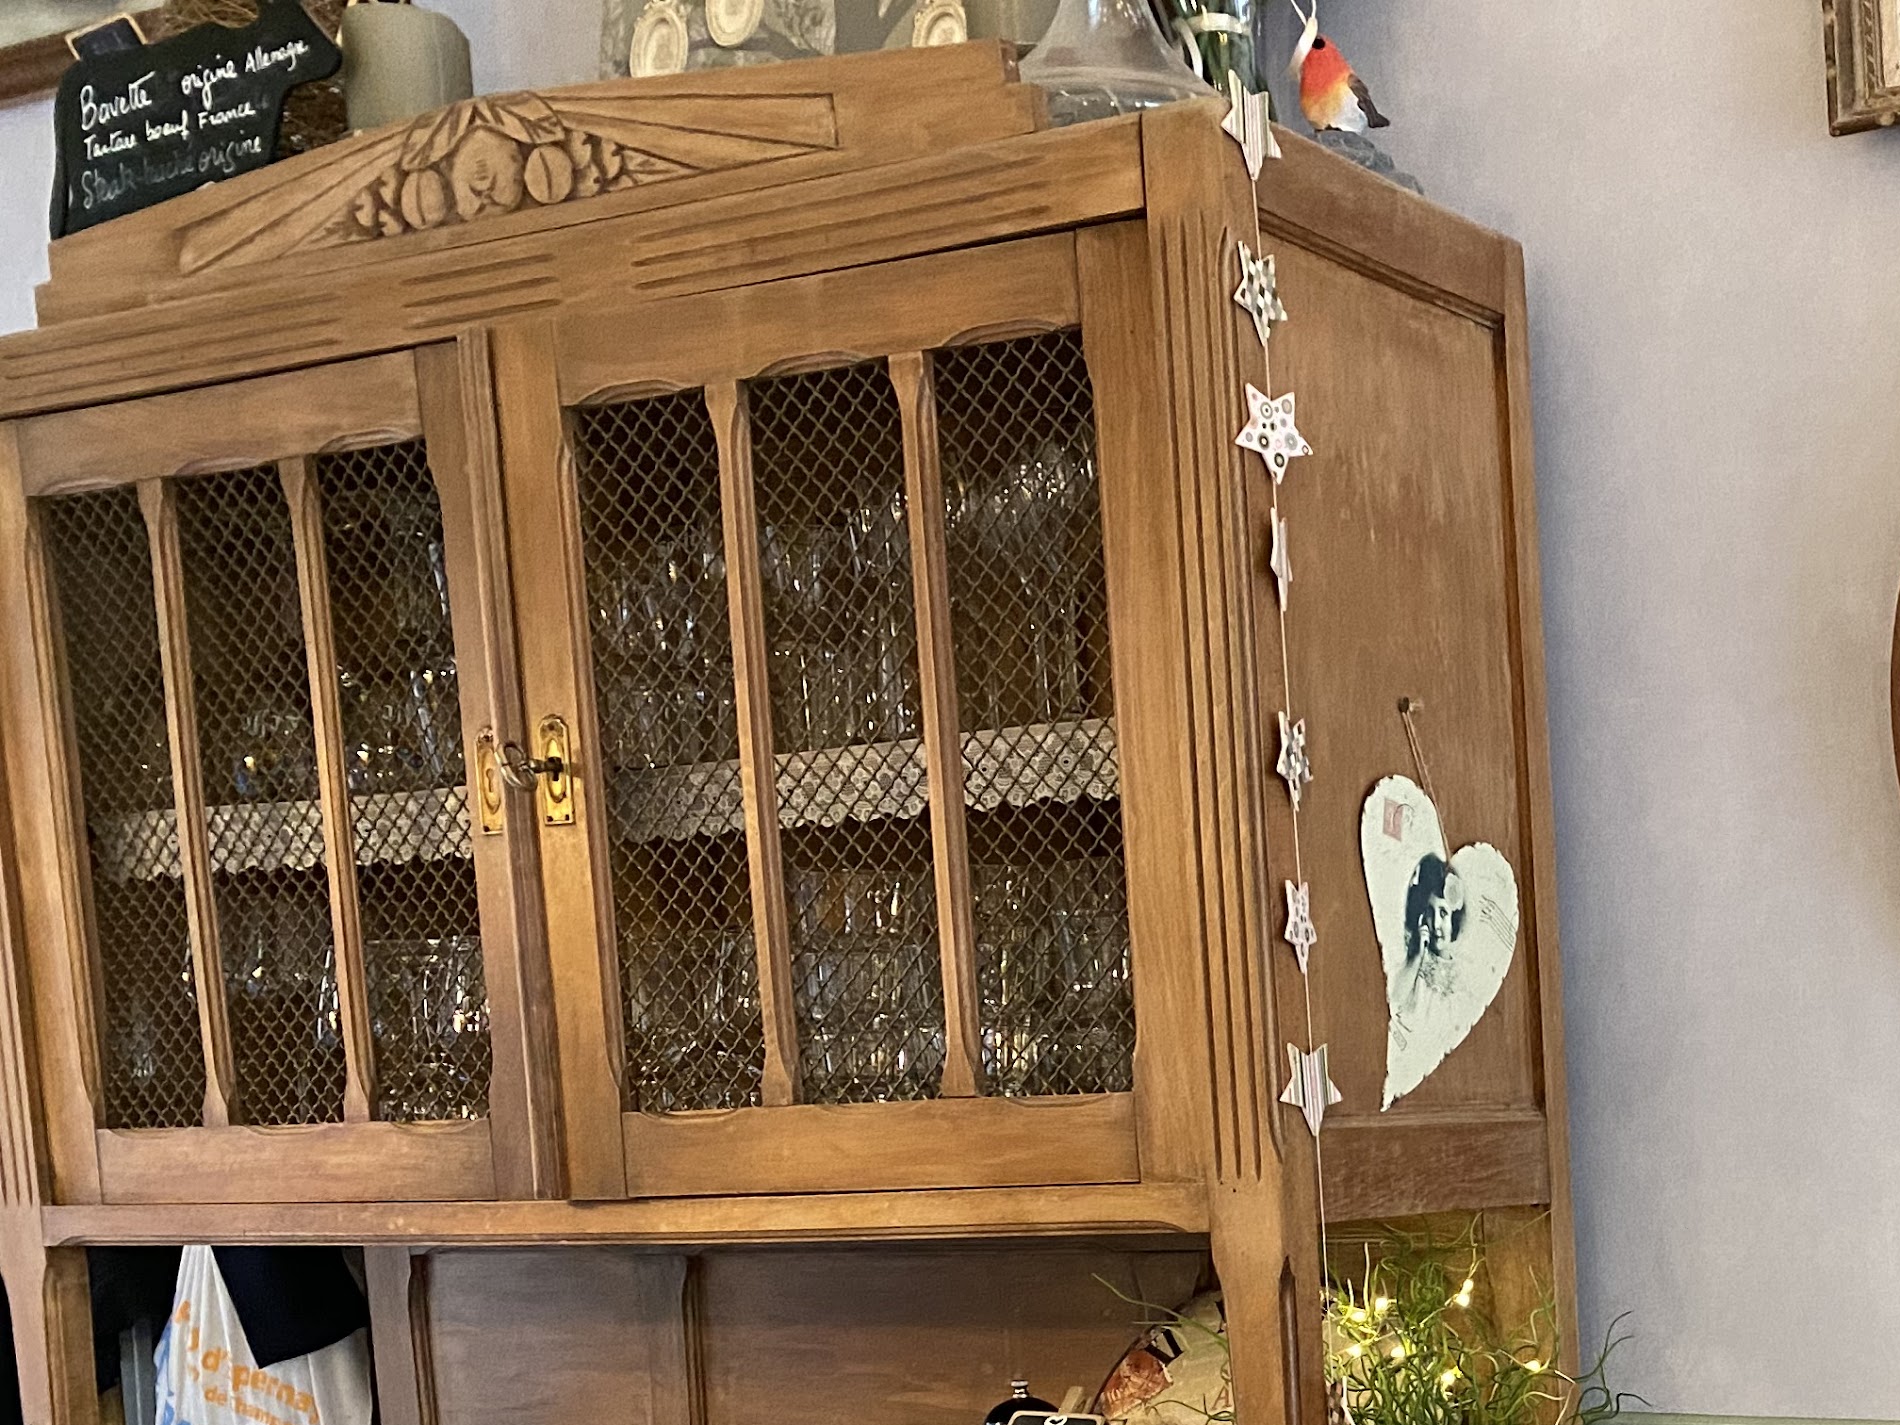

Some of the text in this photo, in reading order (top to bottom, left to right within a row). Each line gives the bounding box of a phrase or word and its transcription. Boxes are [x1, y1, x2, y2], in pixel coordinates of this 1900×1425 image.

[80, 70, 156, 131] Bavette
[181, 53, 237, 110] origine
[198, 102, 256, 129] France
[199, 129, 262, 173] origine
